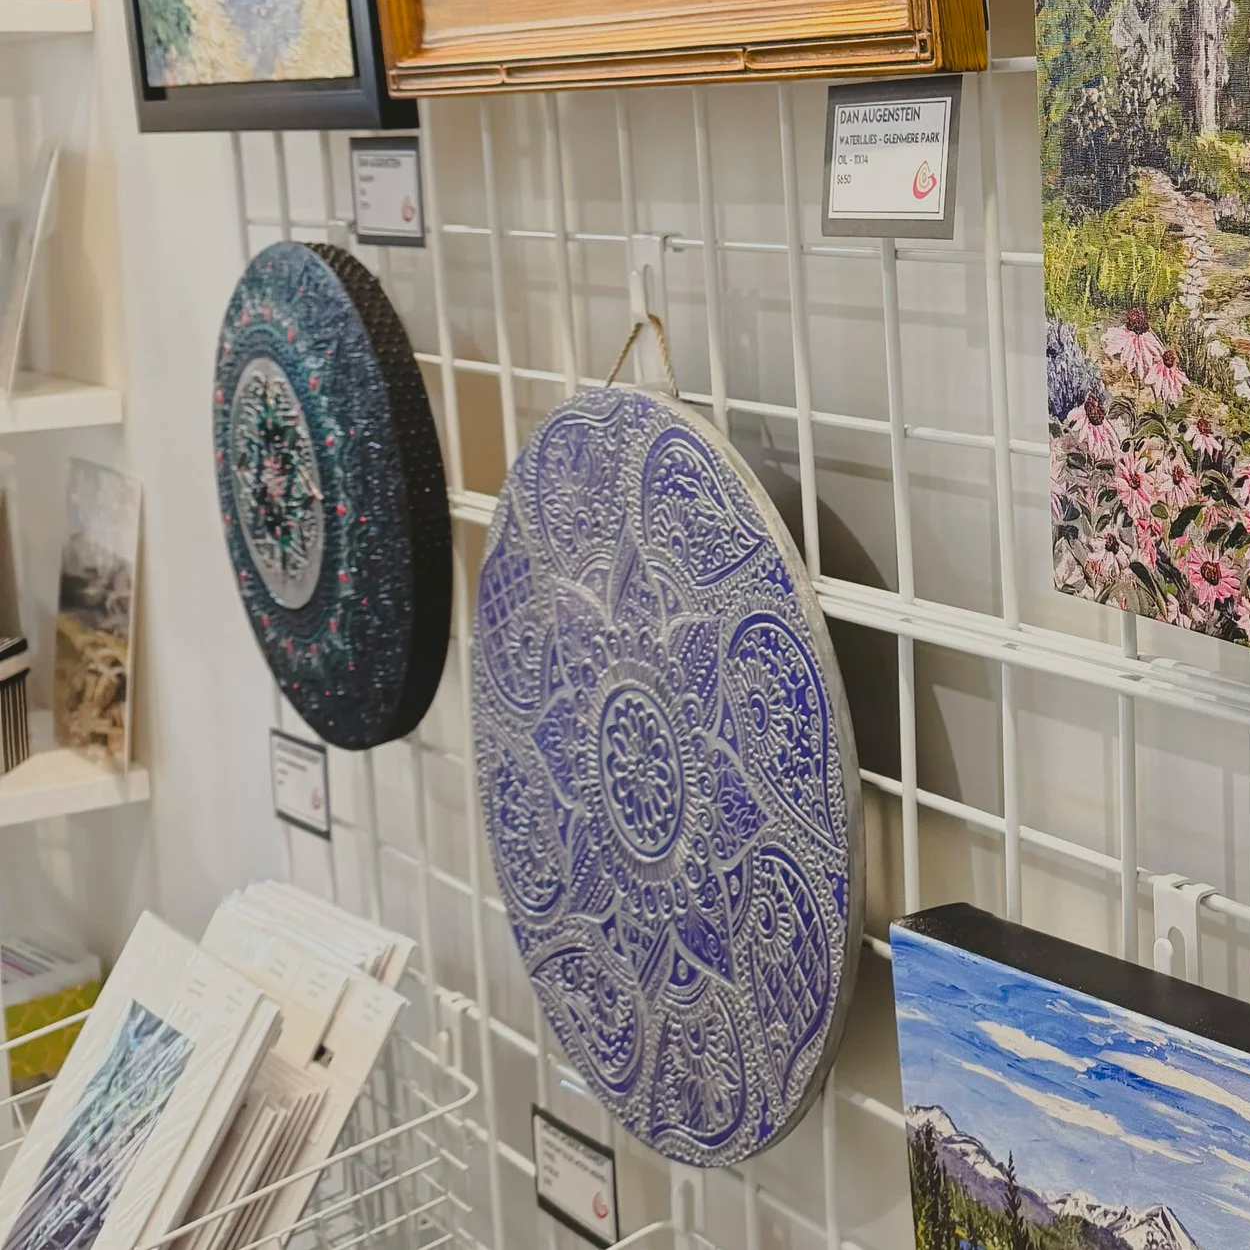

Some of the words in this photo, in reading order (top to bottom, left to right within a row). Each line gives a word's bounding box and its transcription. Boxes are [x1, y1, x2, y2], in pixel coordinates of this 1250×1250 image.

[840, 109, 859, 124] DAN
[861, 106, 920, 123] AUGENSTEIN
[883, 132, 919, 144] GLENMERE
[920, 131, 940, 143] PARK
[837, 154, 847, 164] OIL
